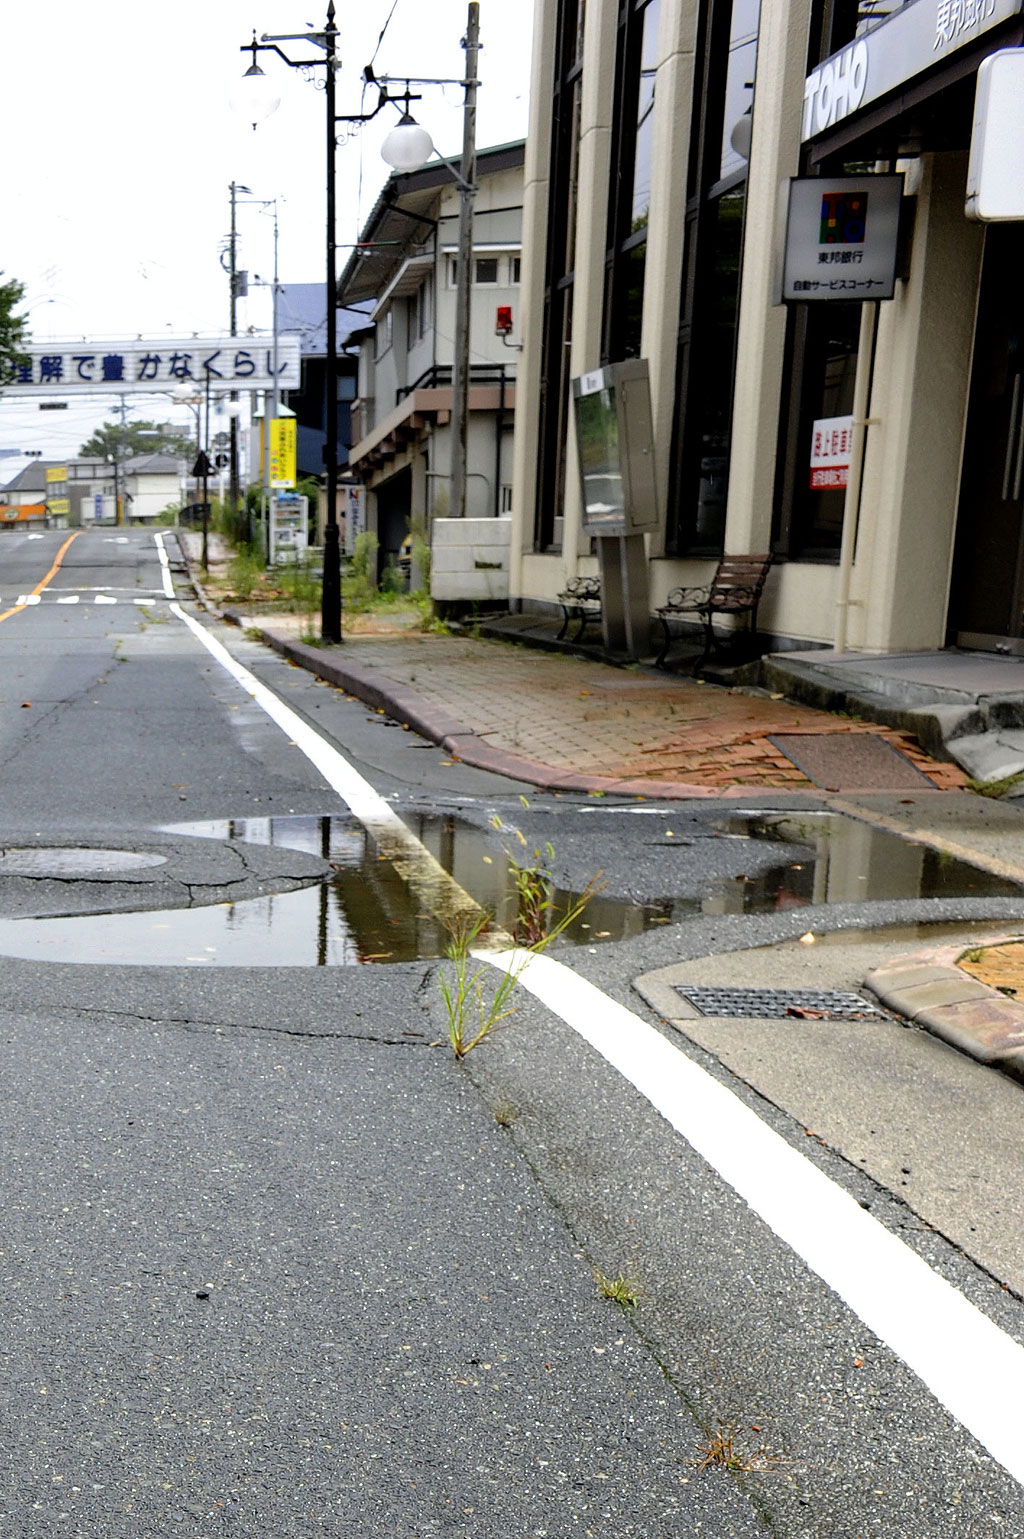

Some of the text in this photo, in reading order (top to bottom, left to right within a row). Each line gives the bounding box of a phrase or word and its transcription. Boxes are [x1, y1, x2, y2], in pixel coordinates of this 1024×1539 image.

[800, 38, 869, 141] TOHO
[818, 250, 864, 265] 東邦銀行
[793, 278, 885, 292] 自動サービスコーナー
